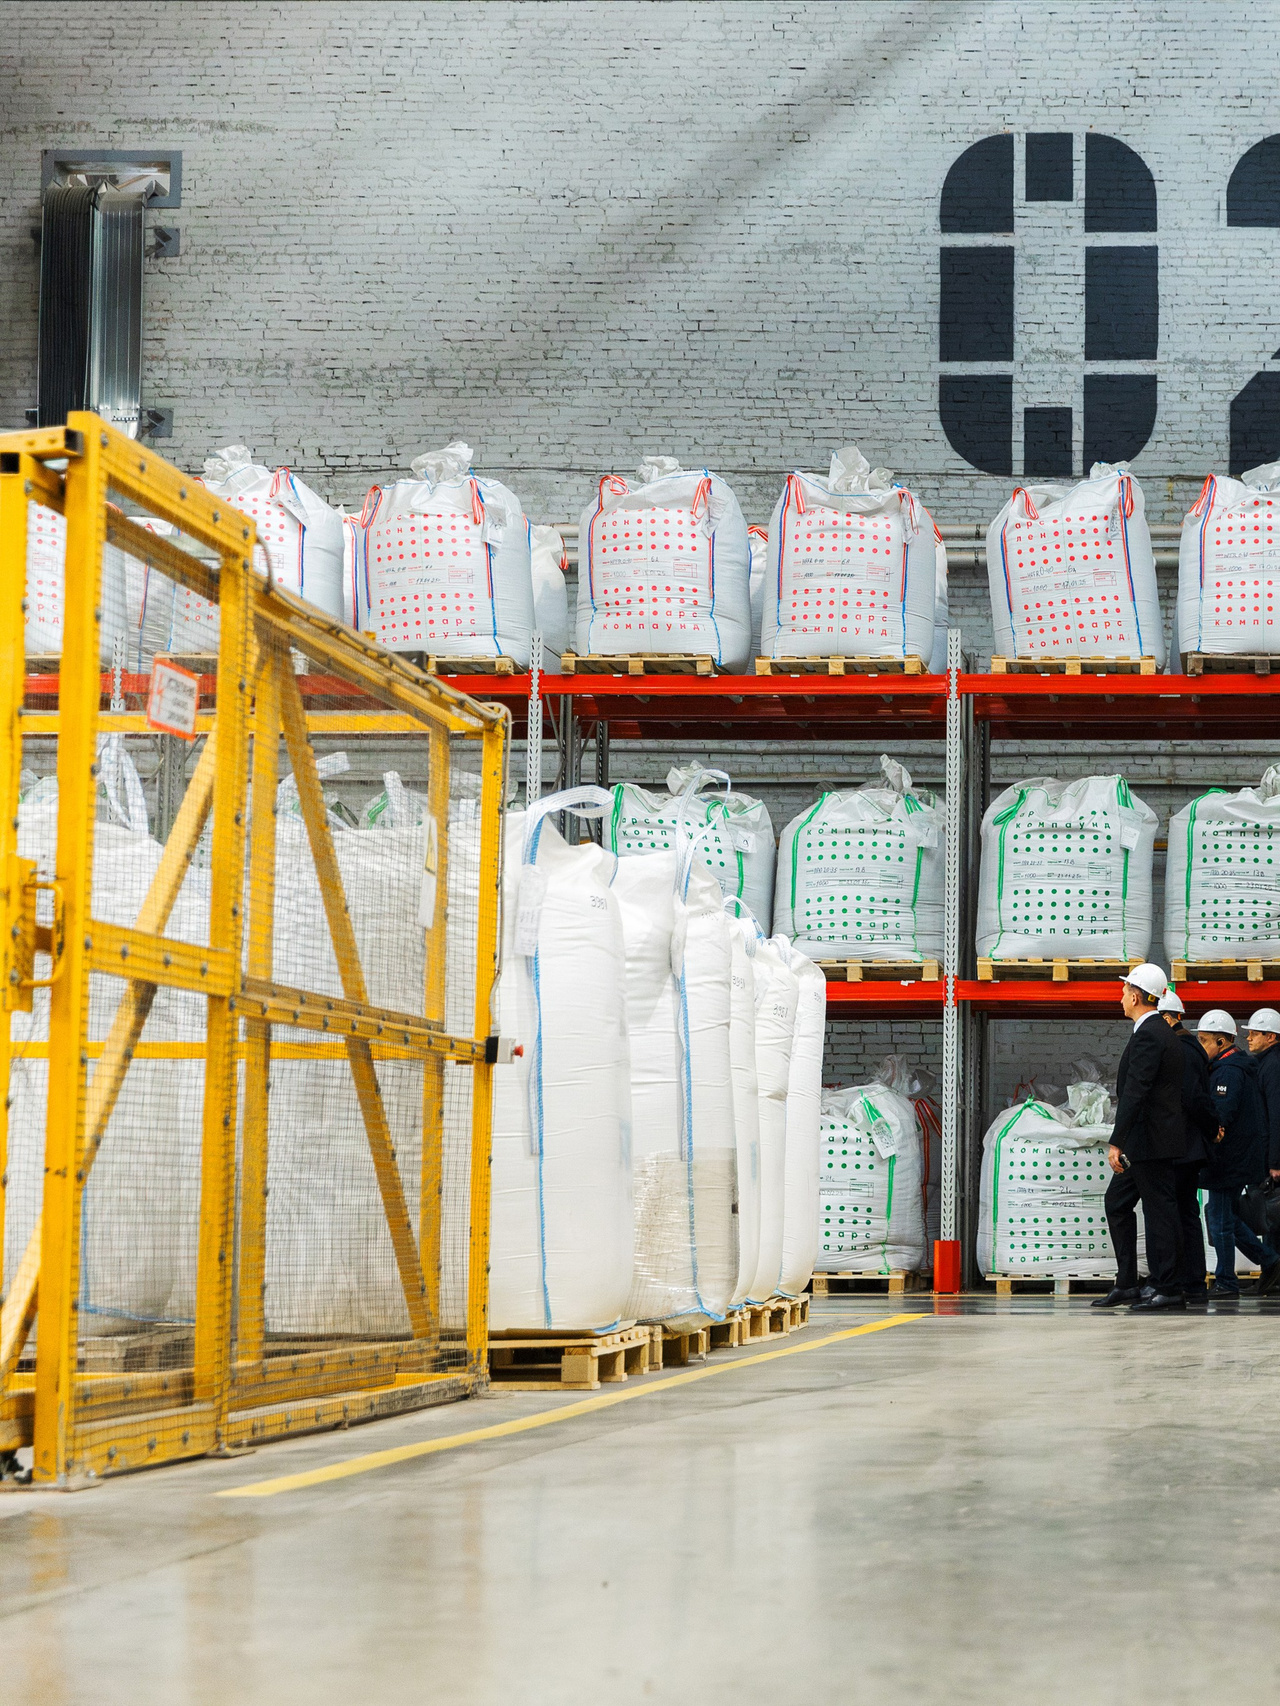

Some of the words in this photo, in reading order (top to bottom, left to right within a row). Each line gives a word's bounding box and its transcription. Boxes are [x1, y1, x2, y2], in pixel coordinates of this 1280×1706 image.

[1015, 520, 1045, 529] арс
[1016, 532, 1046, 542] лен
[666, 610, 698, 618] арс
[855, 614, 887, 622] арс
[442, 618, 475, 626] арс
[1091, 620, 1122, 629] арс
[603, 623, 699, 631] компаунд
[791, 626, 887, 636] компаунд
[1029, 633, 1125, 649] компаунд
[1016, 821, 1110, 830] компаунд
[623, 829, 721, 843] компунд
[807, 827, 905, 837] компаунд
[1077, 915, 1108, 923] арс
[869, 921, 900, 930] арс
[1009, 1147, 1104, 1155] компаунд
[838, 1231, 870, 1240] арс
[1075, 1243, 1107, 1251] арс
